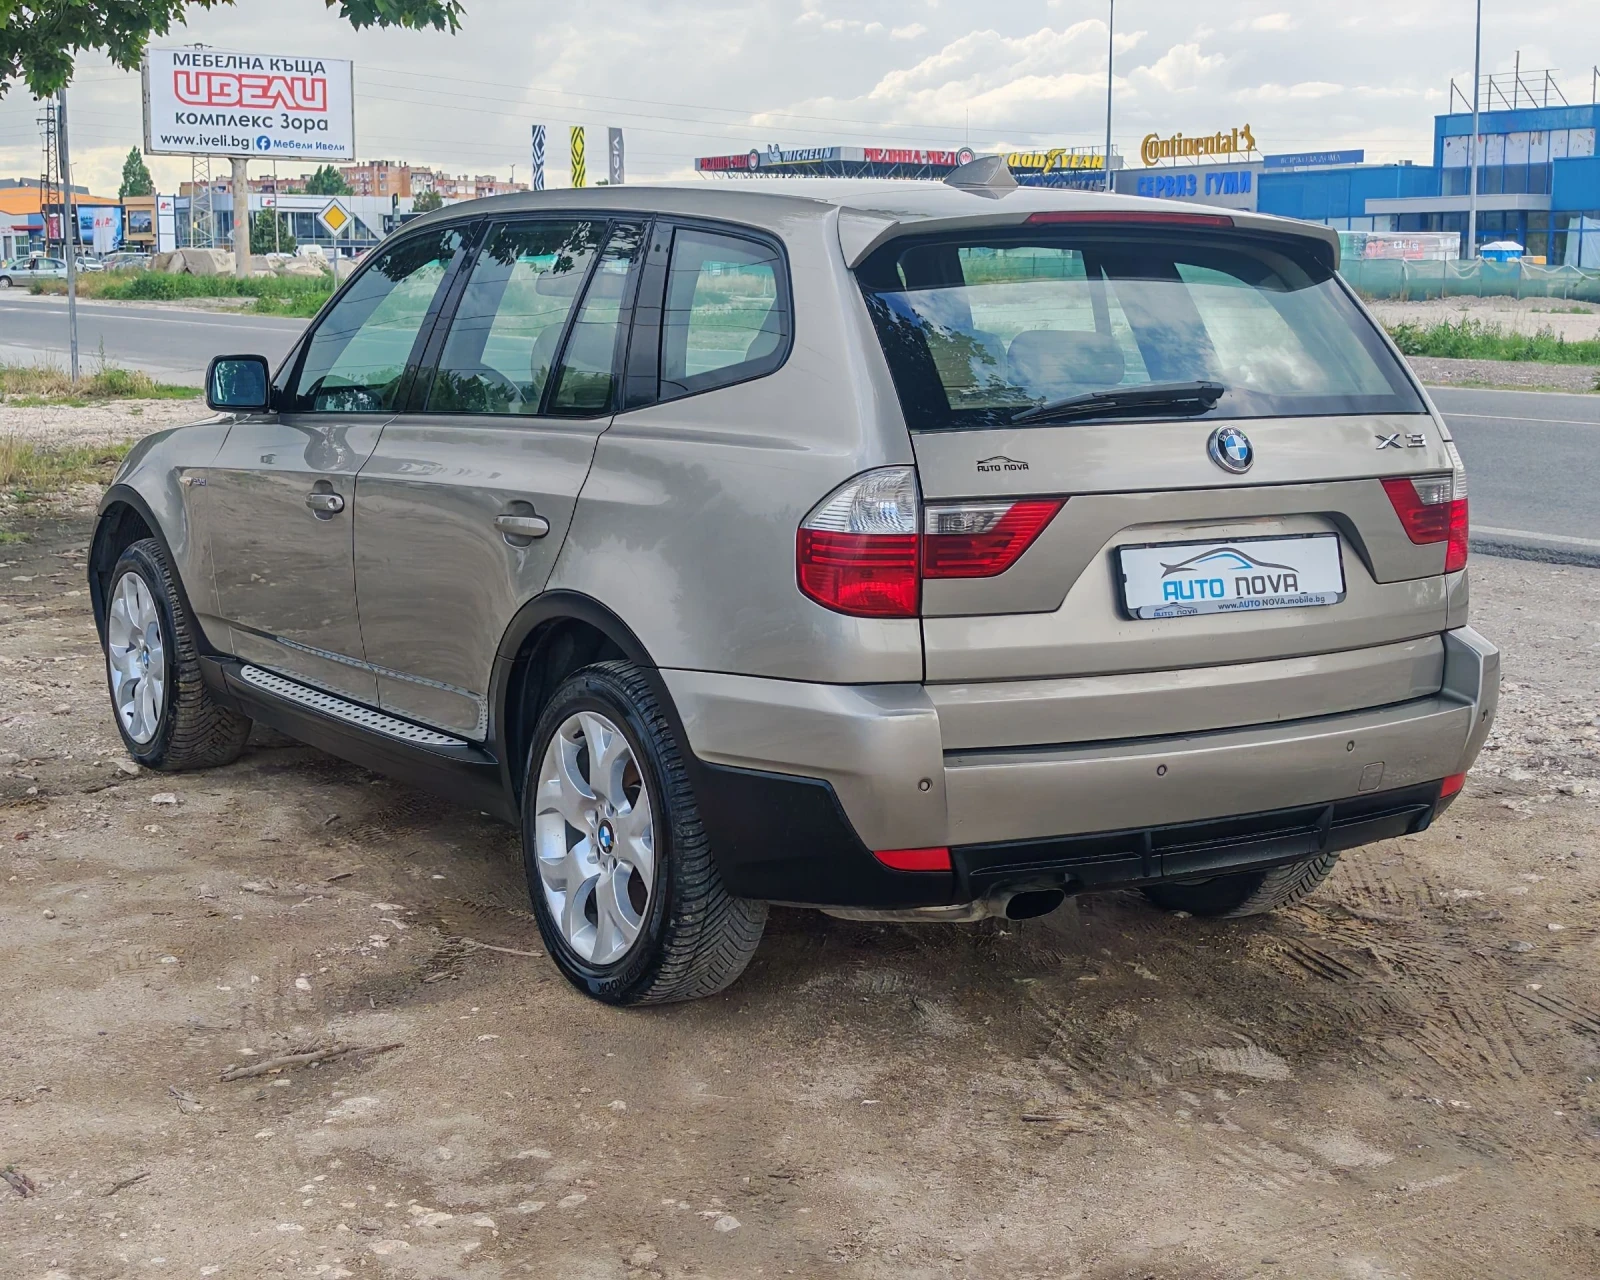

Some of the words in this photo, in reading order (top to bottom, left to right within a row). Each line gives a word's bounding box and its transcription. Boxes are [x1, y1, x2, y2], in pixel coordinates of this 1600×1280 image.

[173, 52, 264, 71] МЕБЕЛНА
[270, 58, 326, 76] КЪЩА
[174, 70, 328, 112] ИВЕЛИ
[175, 112, 273, 128] комплекс
[281, 113, 329, 134] Зора
[160, 134, 250, 150] www.iveli.bg
[273, 139, 313, 149] Мебели
[316, 142, 345, 151] Ивели
[1141, 128, 1238, 166] Continental
[783, 147, 833, 162] MICHELIN
[999, 153, 1104, 168] OODYEAR
[1137, 174, 1197, 198] СЕРВИЗ
[1205, 171, 1252, 196] ГУМИ
[1374, 433, 1426, 450] X3
[977, 464, 1001, 472] AUTO
[1004, 463, 1029, 471] NOVA
[1162, 578, 1225, 601] AUTO
[1235, 573, 1299, 596] NOVA
